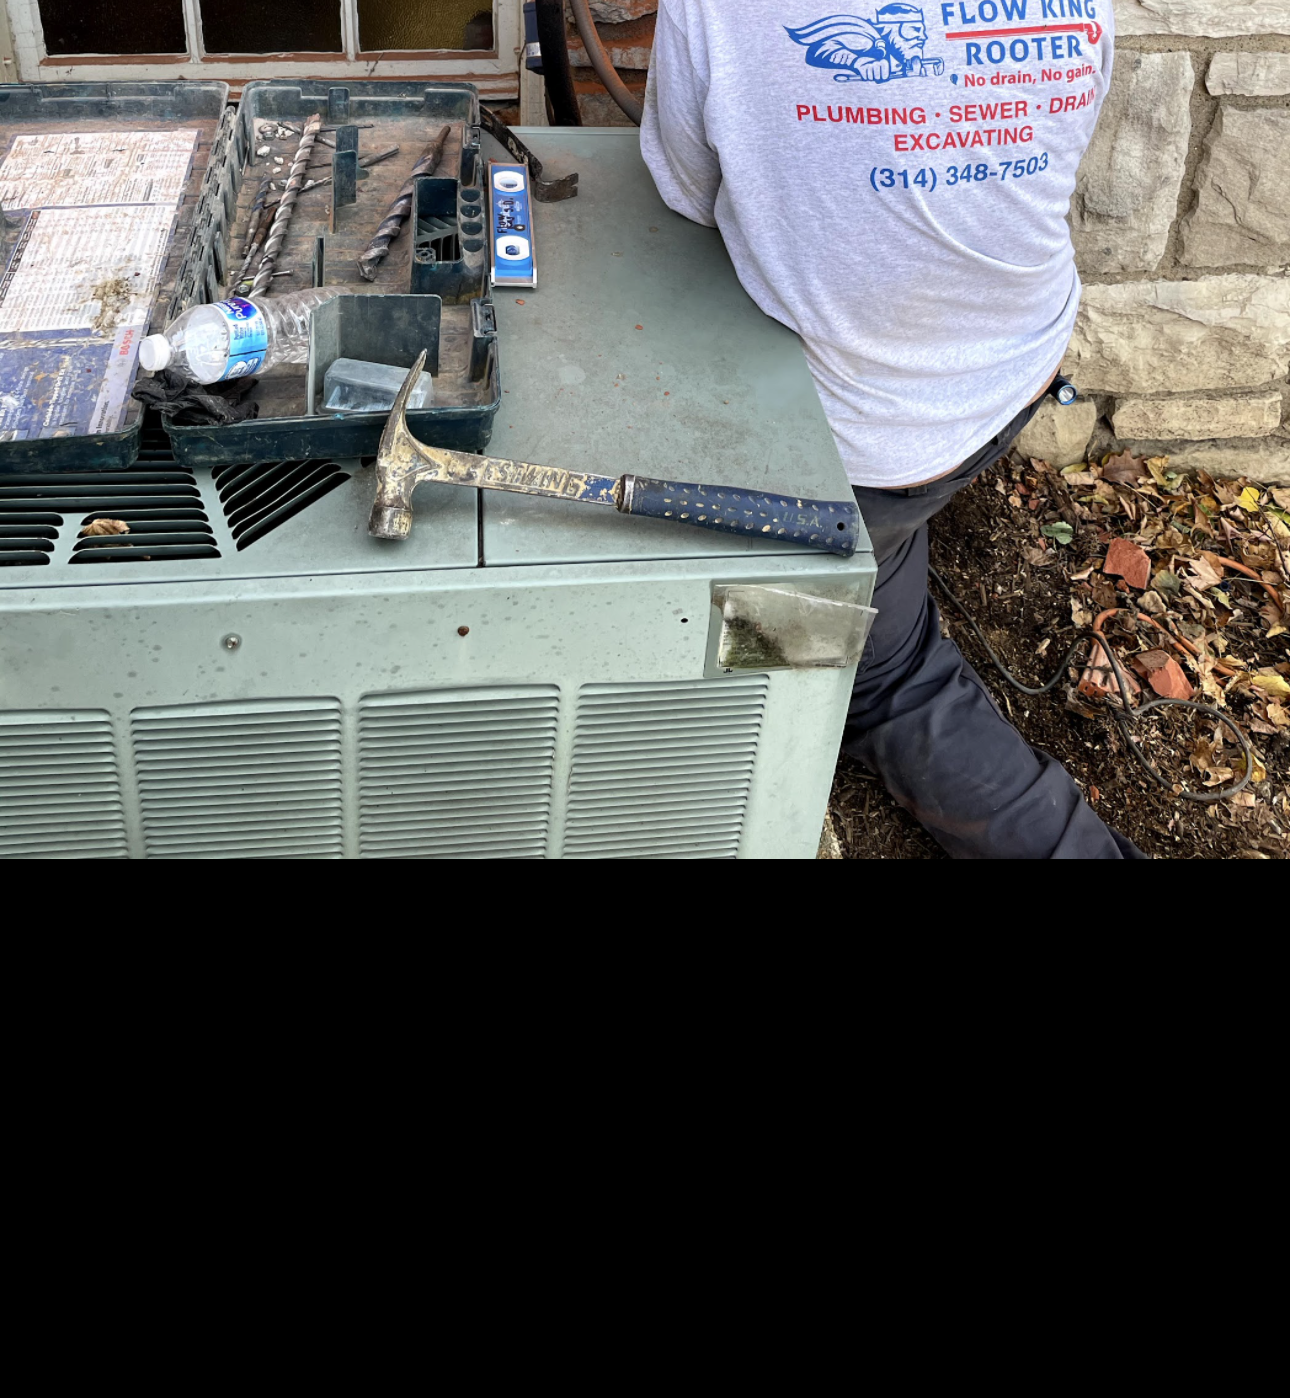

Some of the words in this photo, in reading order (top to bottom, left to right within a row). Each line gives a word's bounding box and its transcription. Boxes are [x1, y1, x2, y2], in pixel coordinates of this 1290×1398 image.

[966, 34, 1083, 66] ROOTER
[964, 73, 986, 88] No
[990, 68, 1037, 86] drain,
[1041, 68, 1063, 82] No
[1066, 63, 1096, 83] gain.
[796, 104, 927, 125] PLUMBING
[949, 101, 1028, 124] SEWER
[893, 125, 1034, 152] EXCAVATING
[869, 166, 937, 193] (314)
[945, 152, 1049, 186] 348-7503
[119, 329, 135, 356] BOSCH
